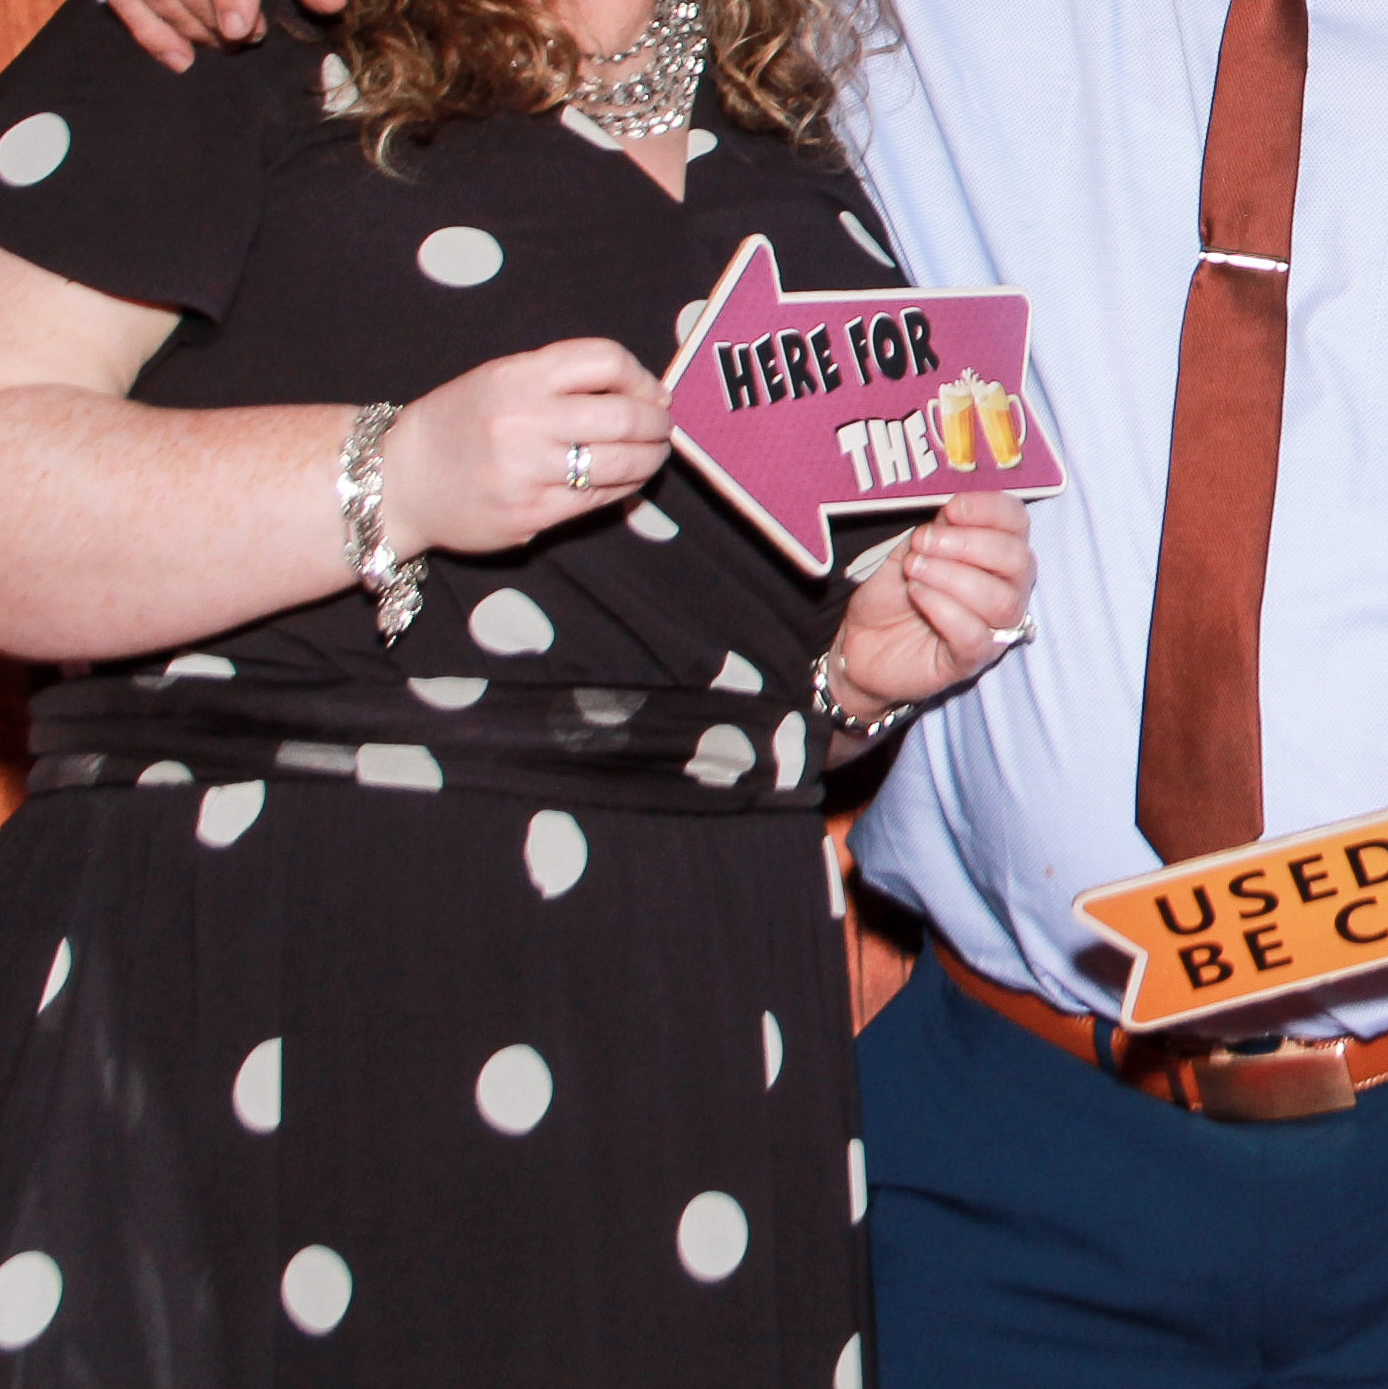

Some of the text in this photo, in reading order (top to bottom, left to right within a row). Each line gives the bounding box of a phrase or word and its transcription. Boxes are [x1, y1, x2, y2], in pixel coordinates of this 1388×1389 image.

[712, 306, 940, 412] HERE FOR
[835, 409, 940, 493] THE
[1177, 922, 1294, 991] BE
